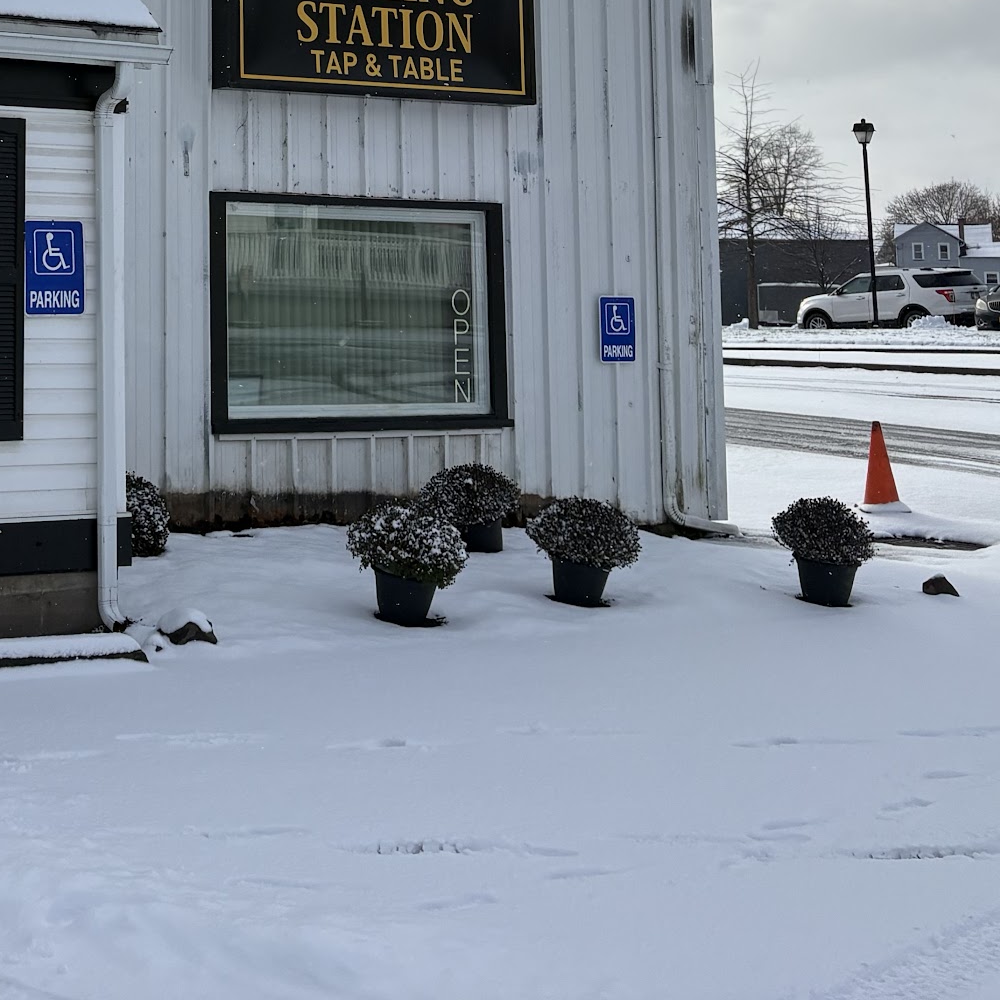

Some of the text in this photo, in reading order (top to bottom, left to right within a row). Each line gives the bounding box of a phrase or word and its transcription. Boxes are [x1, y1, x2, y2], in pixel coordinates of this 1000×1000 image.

[296, 1, 473, 54] STATION
[310, 49, 464, 82] TAP & TABLE
[29, 290, 80, 309] PARKING
[451, 289, 471, 403] OPEN
[603, 344, 634, 358] PARKING
